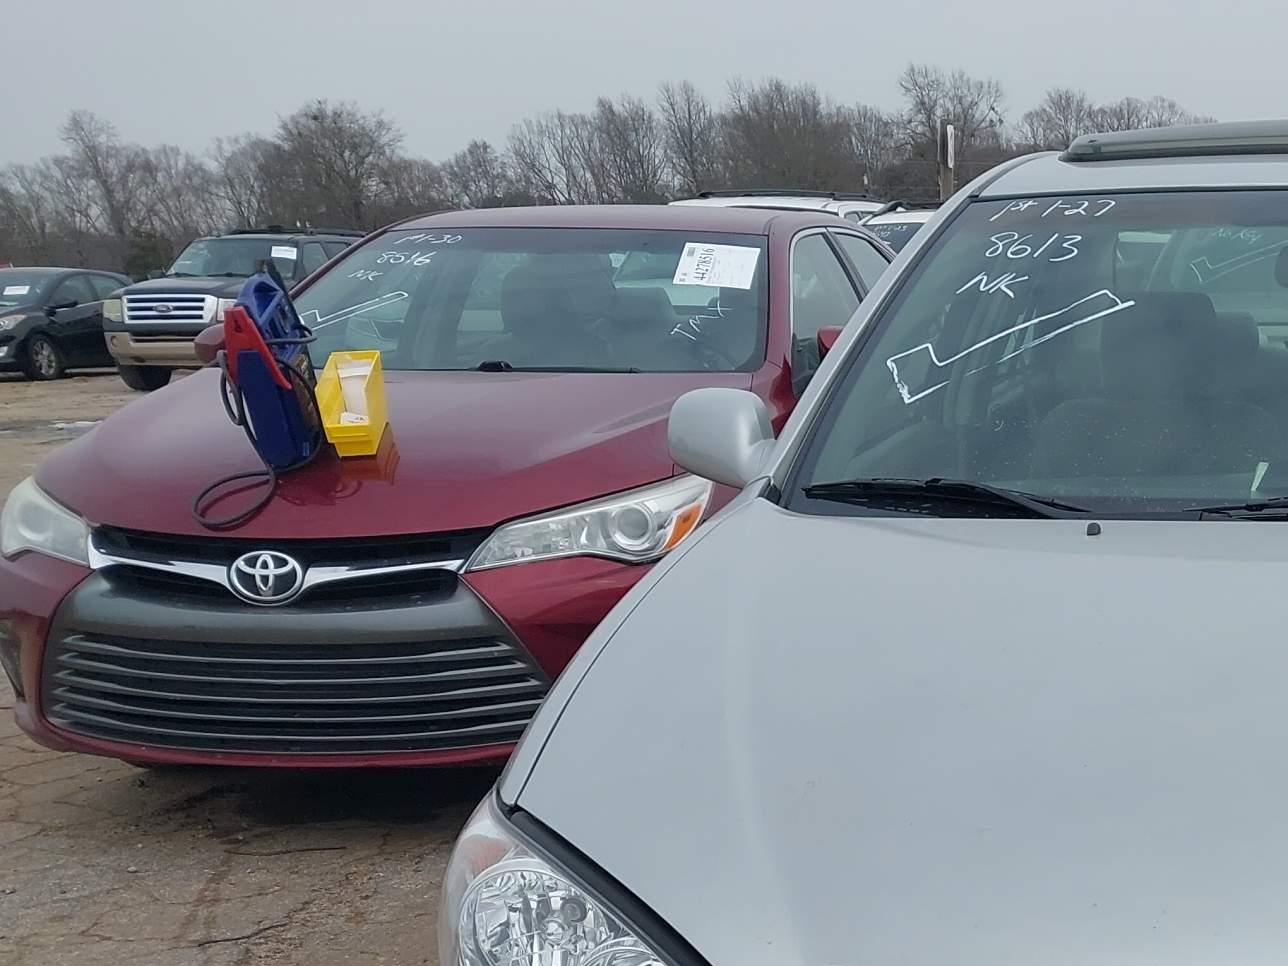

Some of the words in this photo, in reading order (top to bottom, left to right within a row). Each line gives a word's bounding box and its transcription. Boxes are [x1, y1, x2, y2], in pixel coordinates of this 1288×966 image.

[1040, 199, 1117, 218] 1-27
[984, 231, 1083, 262] 8613
[376, 251, 438, 267] 8516
[955, 271, 1029, 299] NK
